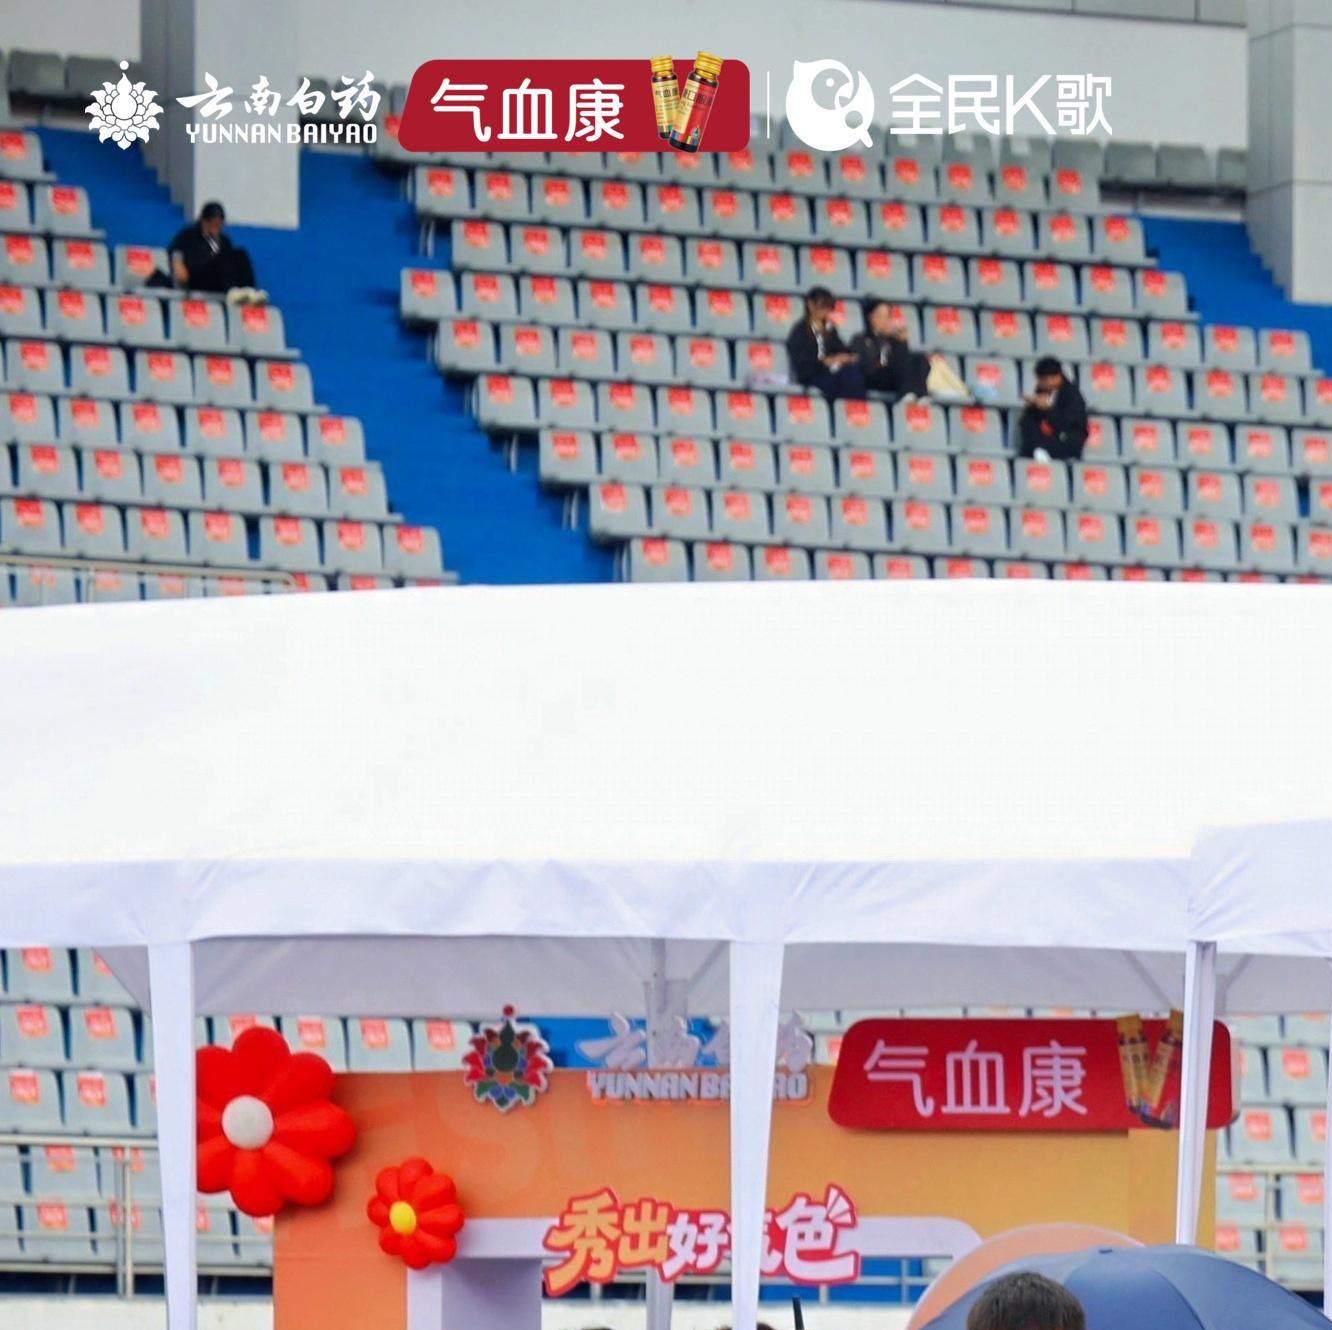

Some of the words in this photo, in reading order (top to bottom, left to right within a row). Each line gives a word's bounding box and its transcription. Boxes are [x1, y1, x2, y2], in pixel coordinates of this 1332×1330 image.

[587, 1070, 699, 1102] YUNNAN
[864, 1039, 1088, 1118] 气血康
